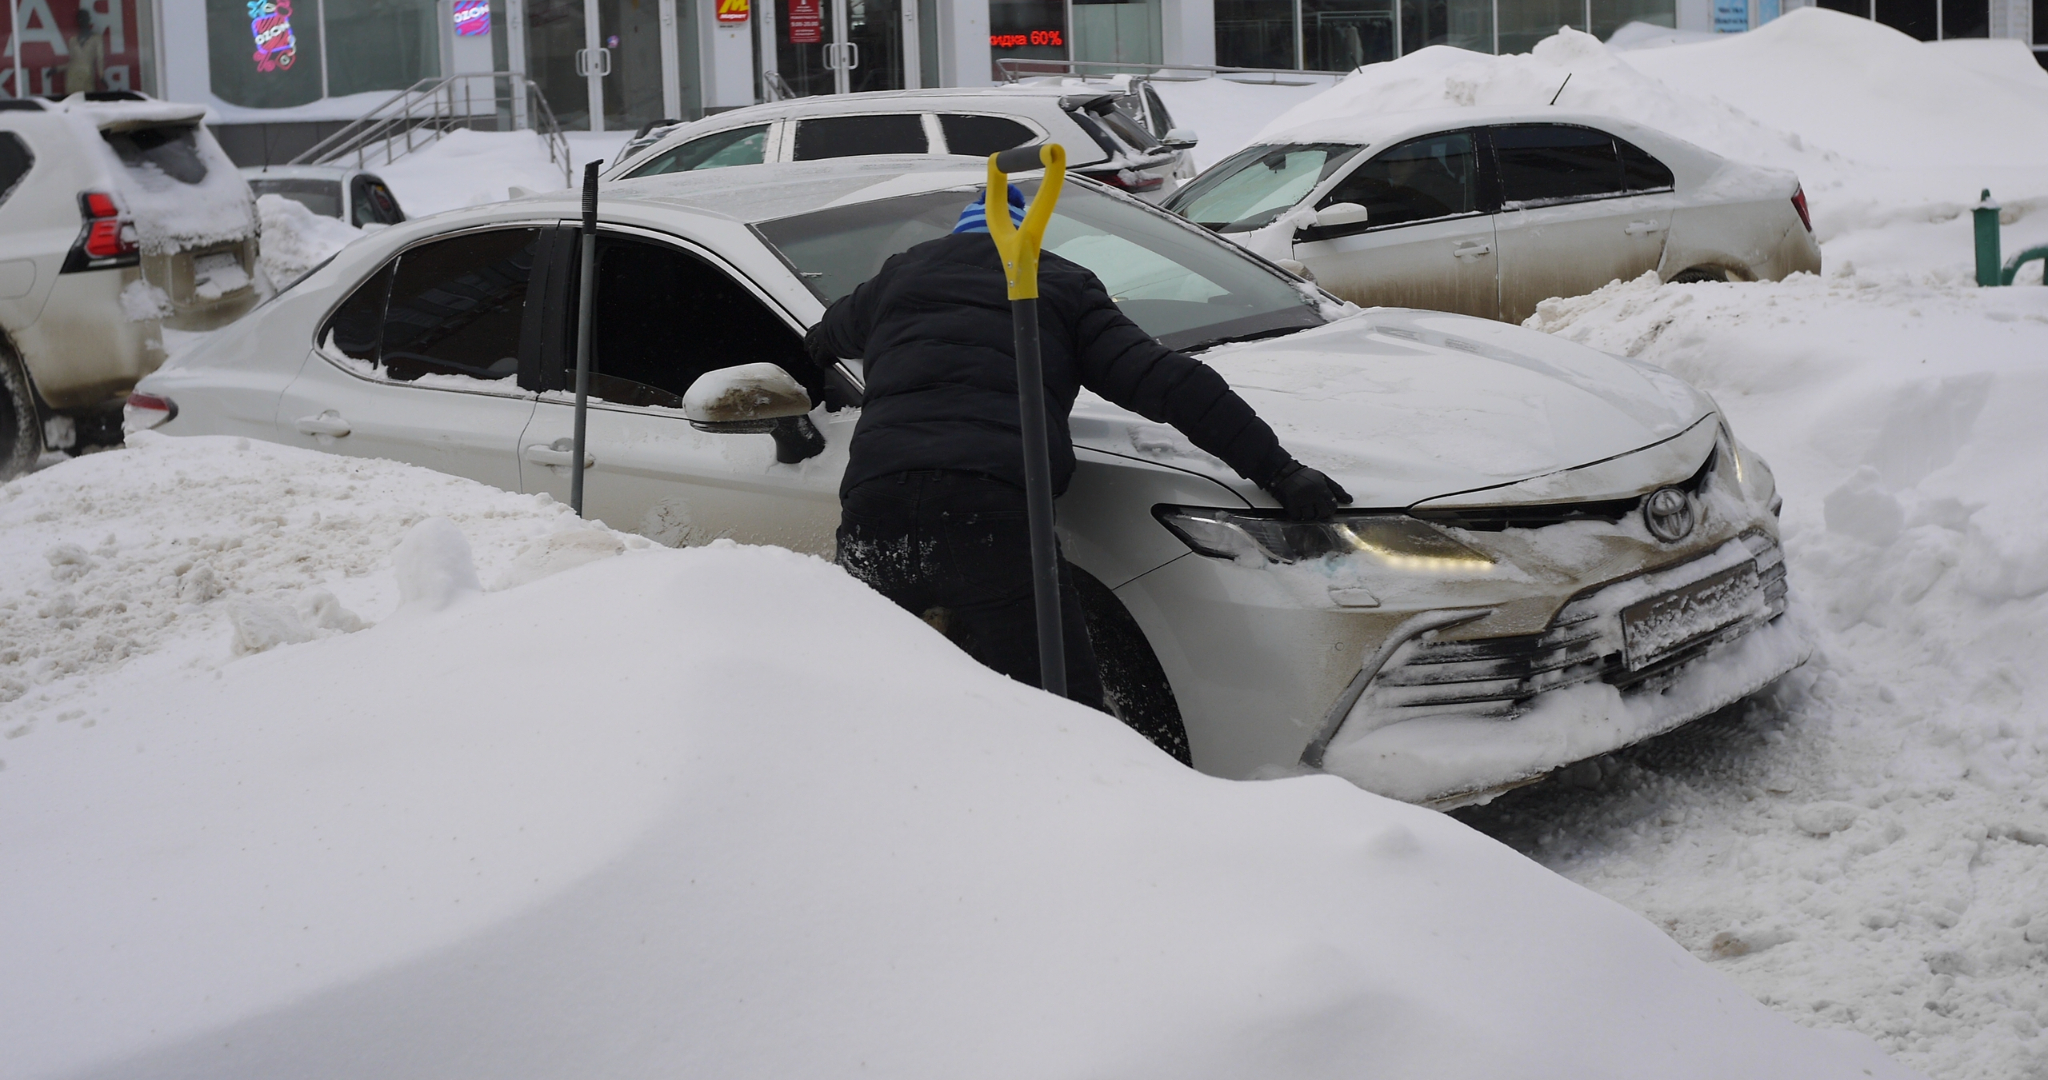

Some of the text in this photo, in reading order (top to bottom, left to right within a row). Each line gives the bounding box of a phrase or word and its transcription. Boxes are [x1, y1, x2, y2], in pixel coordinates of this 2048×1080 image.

[453, 4, 490, 23] OZON
[255, 22, 291, 45] OZON
[1031, 30, 1062, 46] 60%
